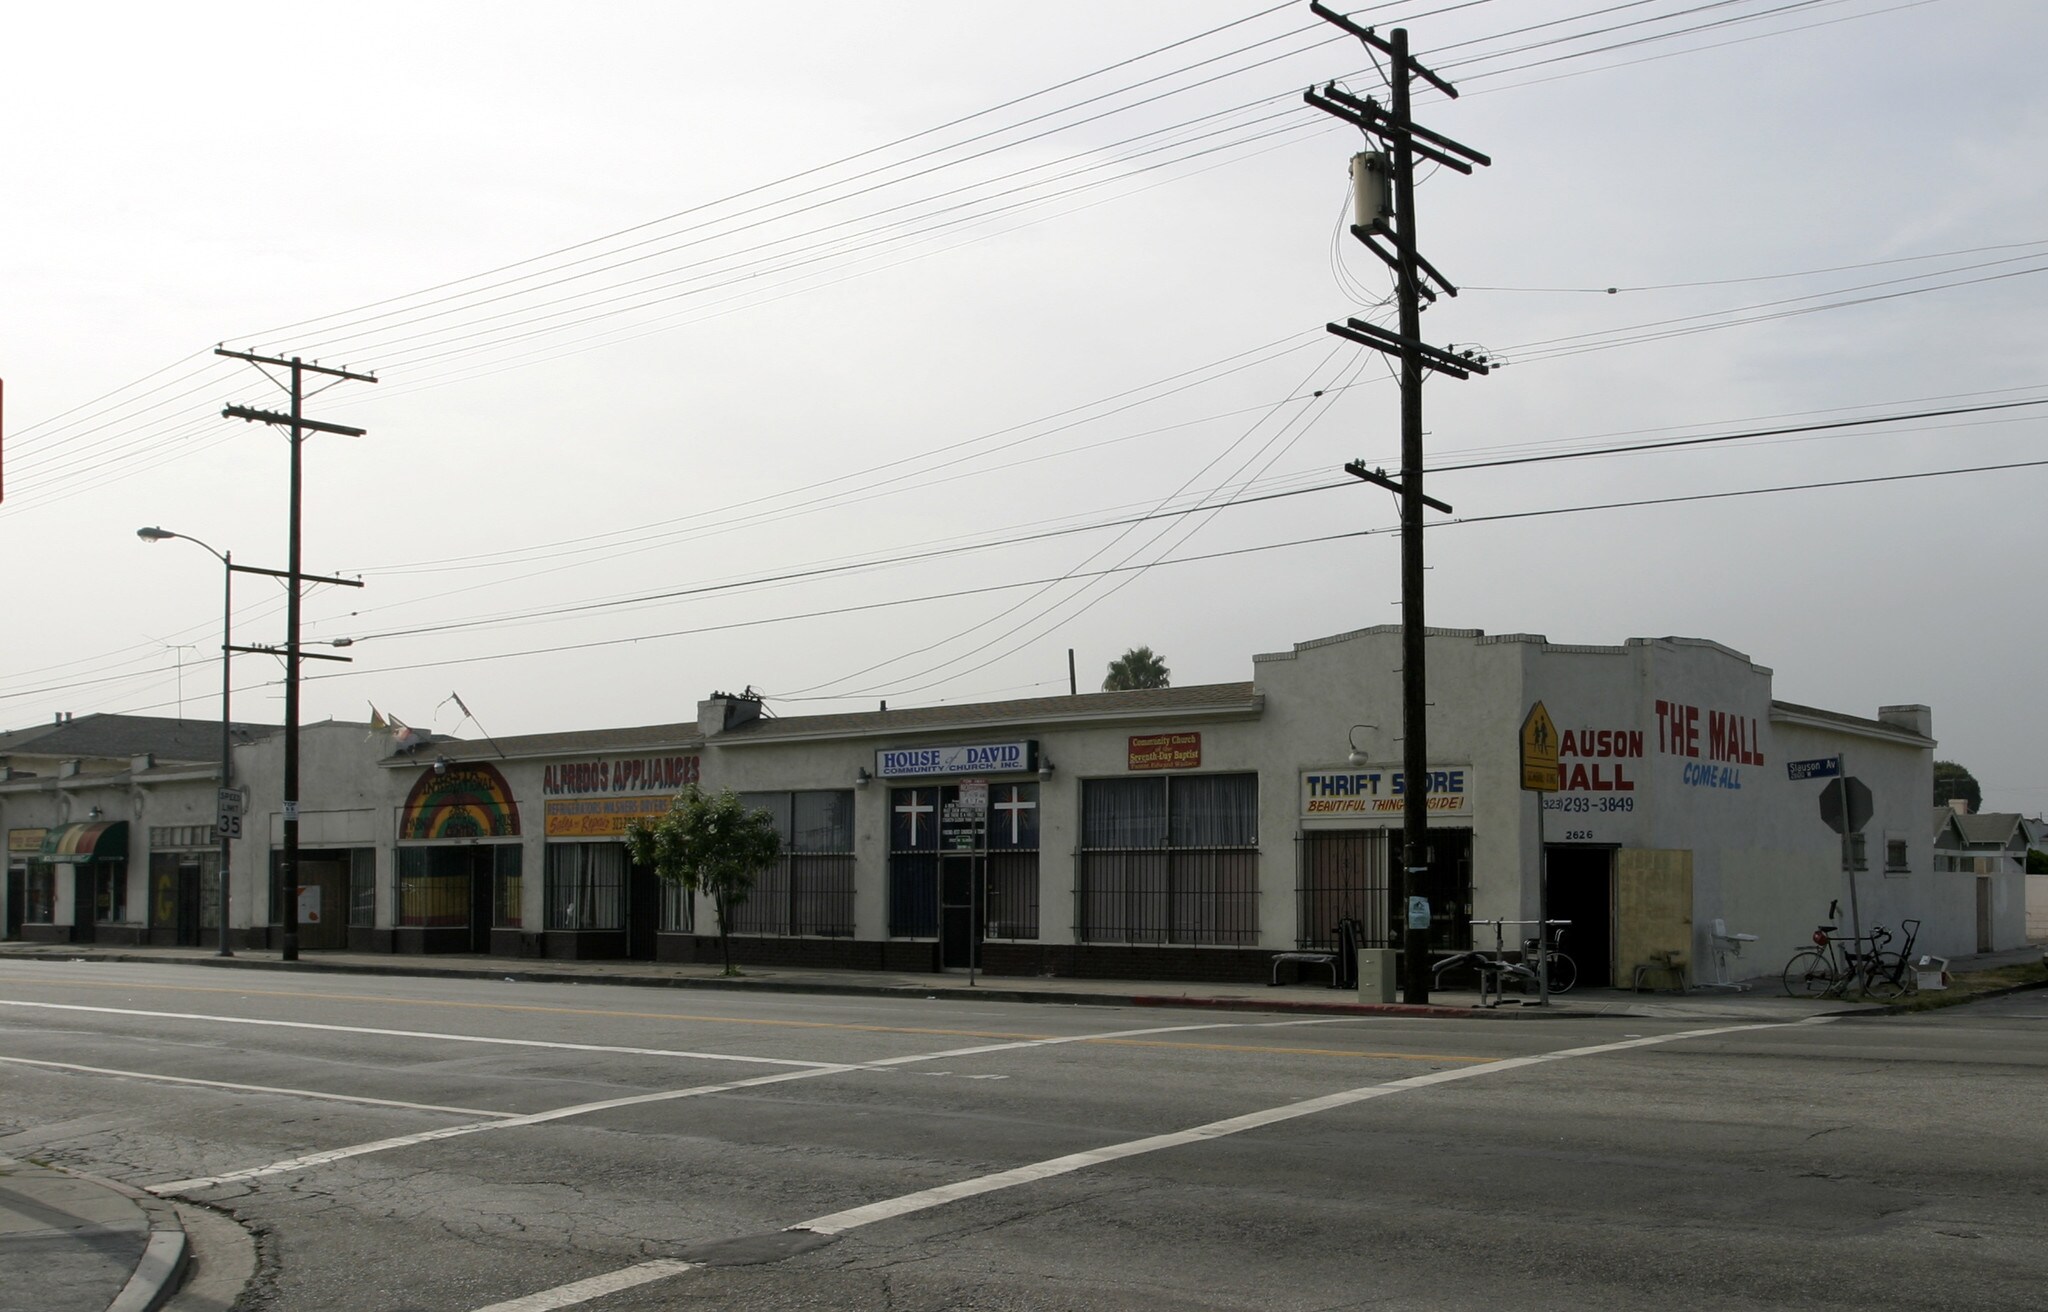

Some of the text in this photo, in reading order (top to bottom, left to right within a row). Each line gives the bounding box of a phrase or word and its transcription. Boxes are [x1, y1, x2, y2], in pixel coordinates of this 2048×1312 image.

[1133, 735, 1196, 747] Community Church
[1655, 700, 1764, 767] THE MALL
[1559, 730, 1643, 758] AUSON
[884, 751, 940, 768] HOUSE
[967, 746, 1020, 764] DAVID
[1130, 750, 1199, 762] Seventh-Day Baptist
[883, 761, 1023, 774] COMMUNITY CHURCH, INC.
[1790, 760, 1836, 773] Slauson Av
[543, 756, 700, 795] ALFREDO'S APPLIANCES
[1683, 762, 1742, 789] COME ALL
[1307, 771, 1464, 797] THRIFT SORE
[220, 791, 241, 802] SPEED
[222, 803, 239, 813] LIMIT
[1307, 800, 1366, 812] BEAUTIFUL
[1372, 798, 1407, 811] THING
[1542, 797, 1634, 813] 323)293-3849
[219, 814, 240, 834] 35
[1565, 831, 1593, 840] 2626
